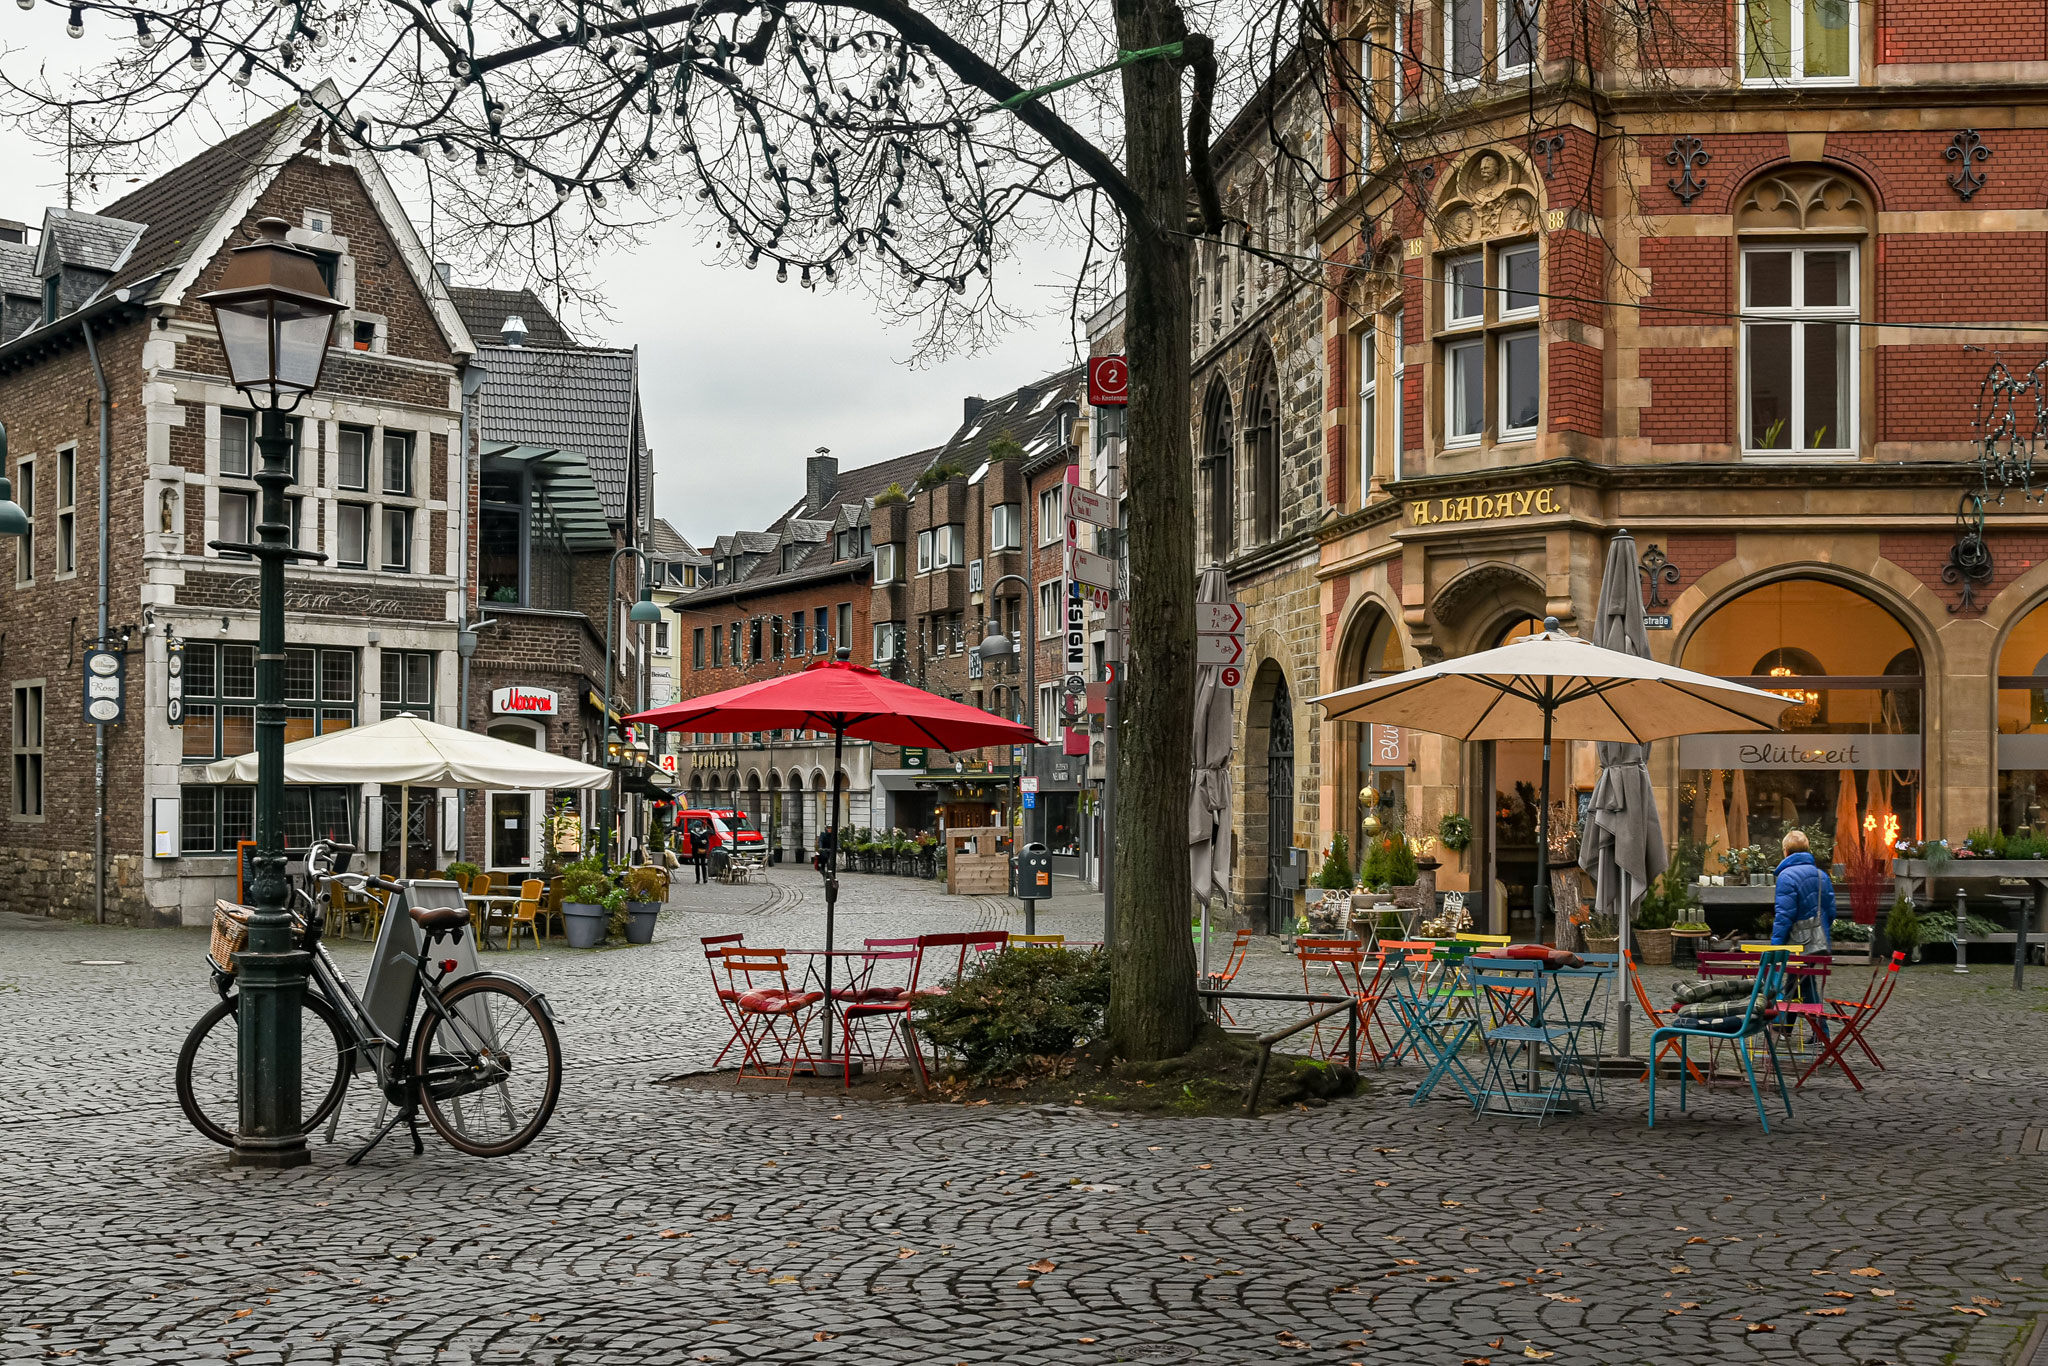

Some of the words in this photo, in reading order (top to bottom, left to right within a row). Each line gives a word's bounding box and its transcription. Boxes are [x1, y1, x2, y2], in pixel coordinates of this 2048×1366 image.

[1548, 211, 1564, 229] 88
[1408, 239, 1422, 256] 18
[1108, 369, 1118, 383] 2
[1215, 640, 1220, 648] 3
[1227, 671, 1235, 683] 5
[91, 681, 117, 692] Rose
[691, 751, 736, 769] Apotheke
[1739, 743, 1860, 764] Blütezeit
